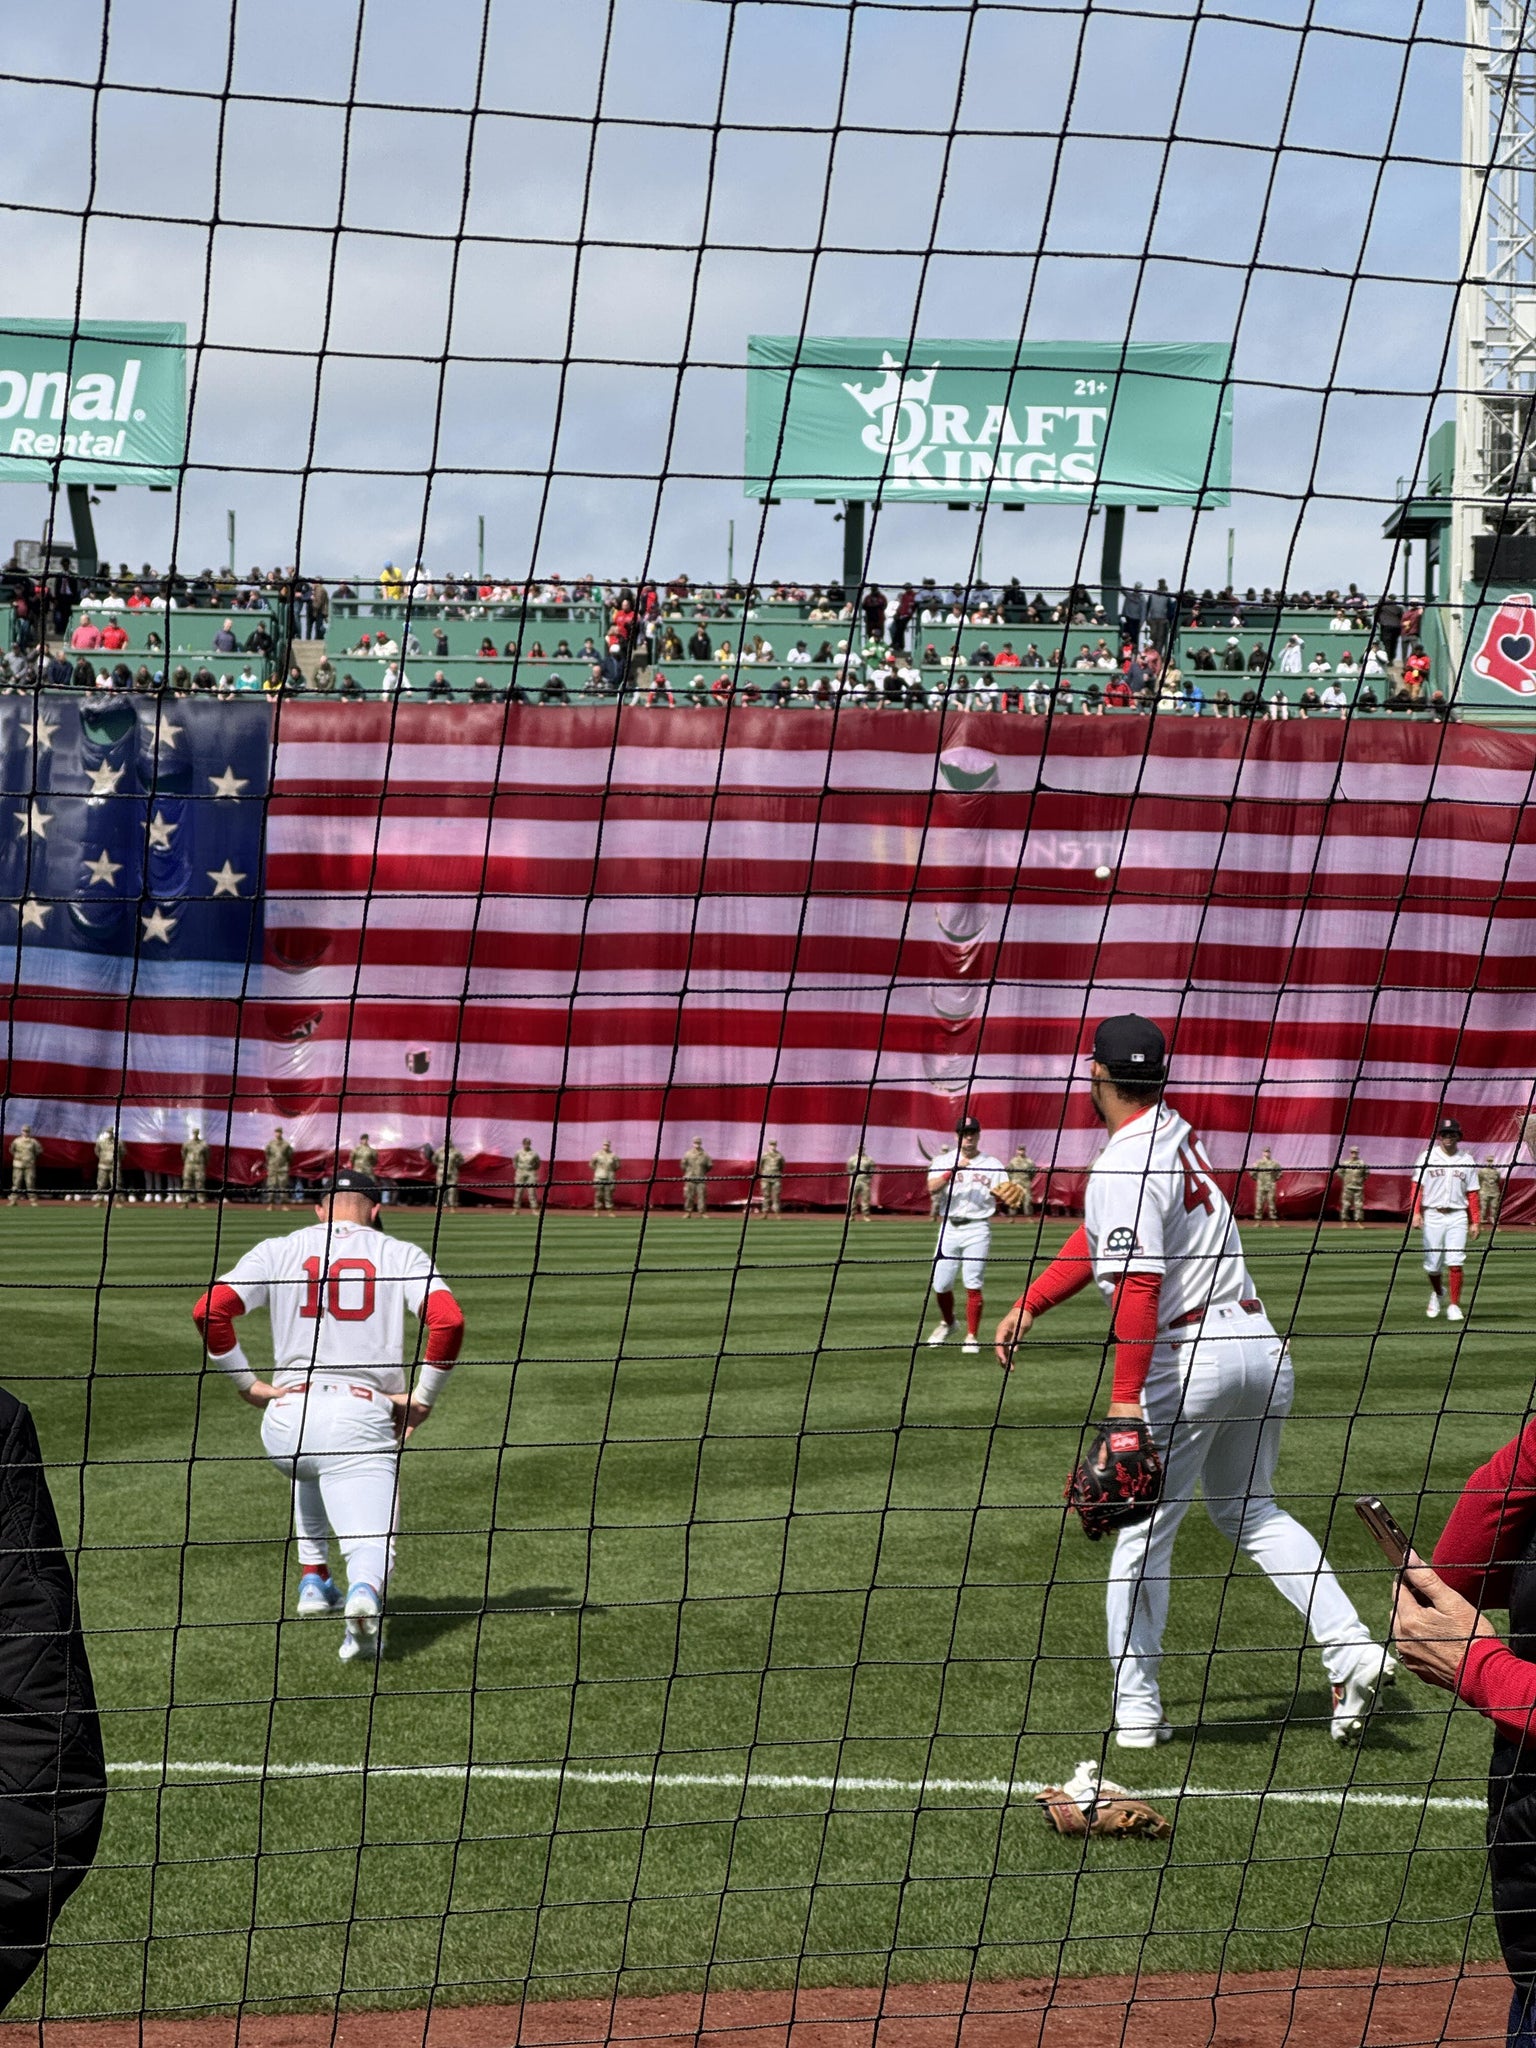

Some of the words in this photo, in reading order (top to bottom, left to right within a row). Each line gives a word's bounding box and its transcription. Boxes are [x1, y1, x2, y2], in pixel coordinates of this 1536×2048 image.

[1074, 379, 1108, 396] 21+
[9, 428, 126, 457] Rental
[861, 400, 1107, 455] DRAFT
[890, 446, 1097, 492] KINGS
[299, 1255, 377, 1321] 10
